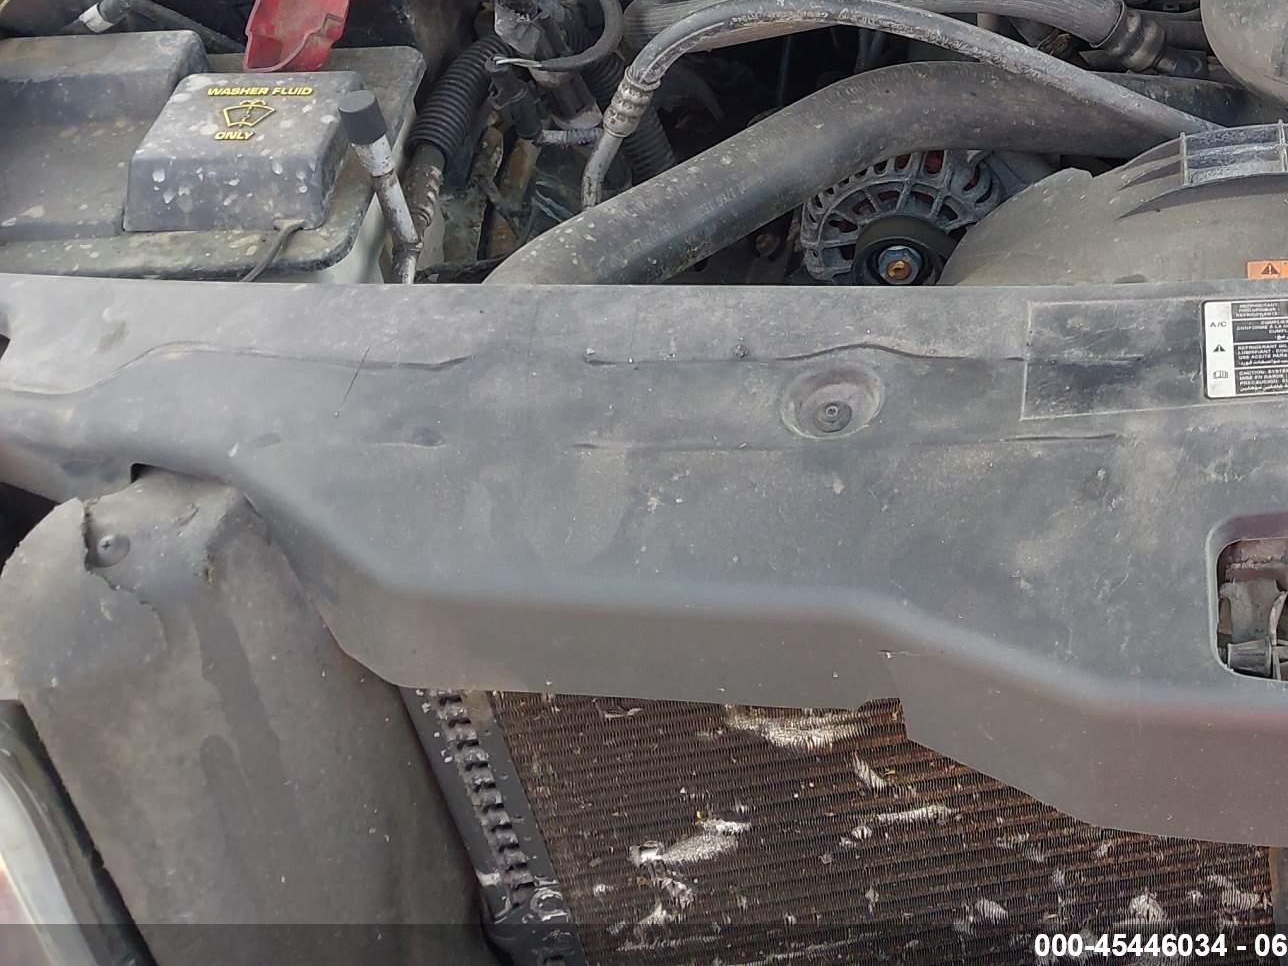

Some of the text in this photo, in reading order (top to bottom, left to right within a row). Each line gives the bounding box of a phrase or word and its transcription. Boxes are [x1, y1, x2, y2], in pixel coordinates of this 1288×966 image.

[207, 86, 314, 96] WASHER FLUID
[214, 131, 255, 140] ONLY
